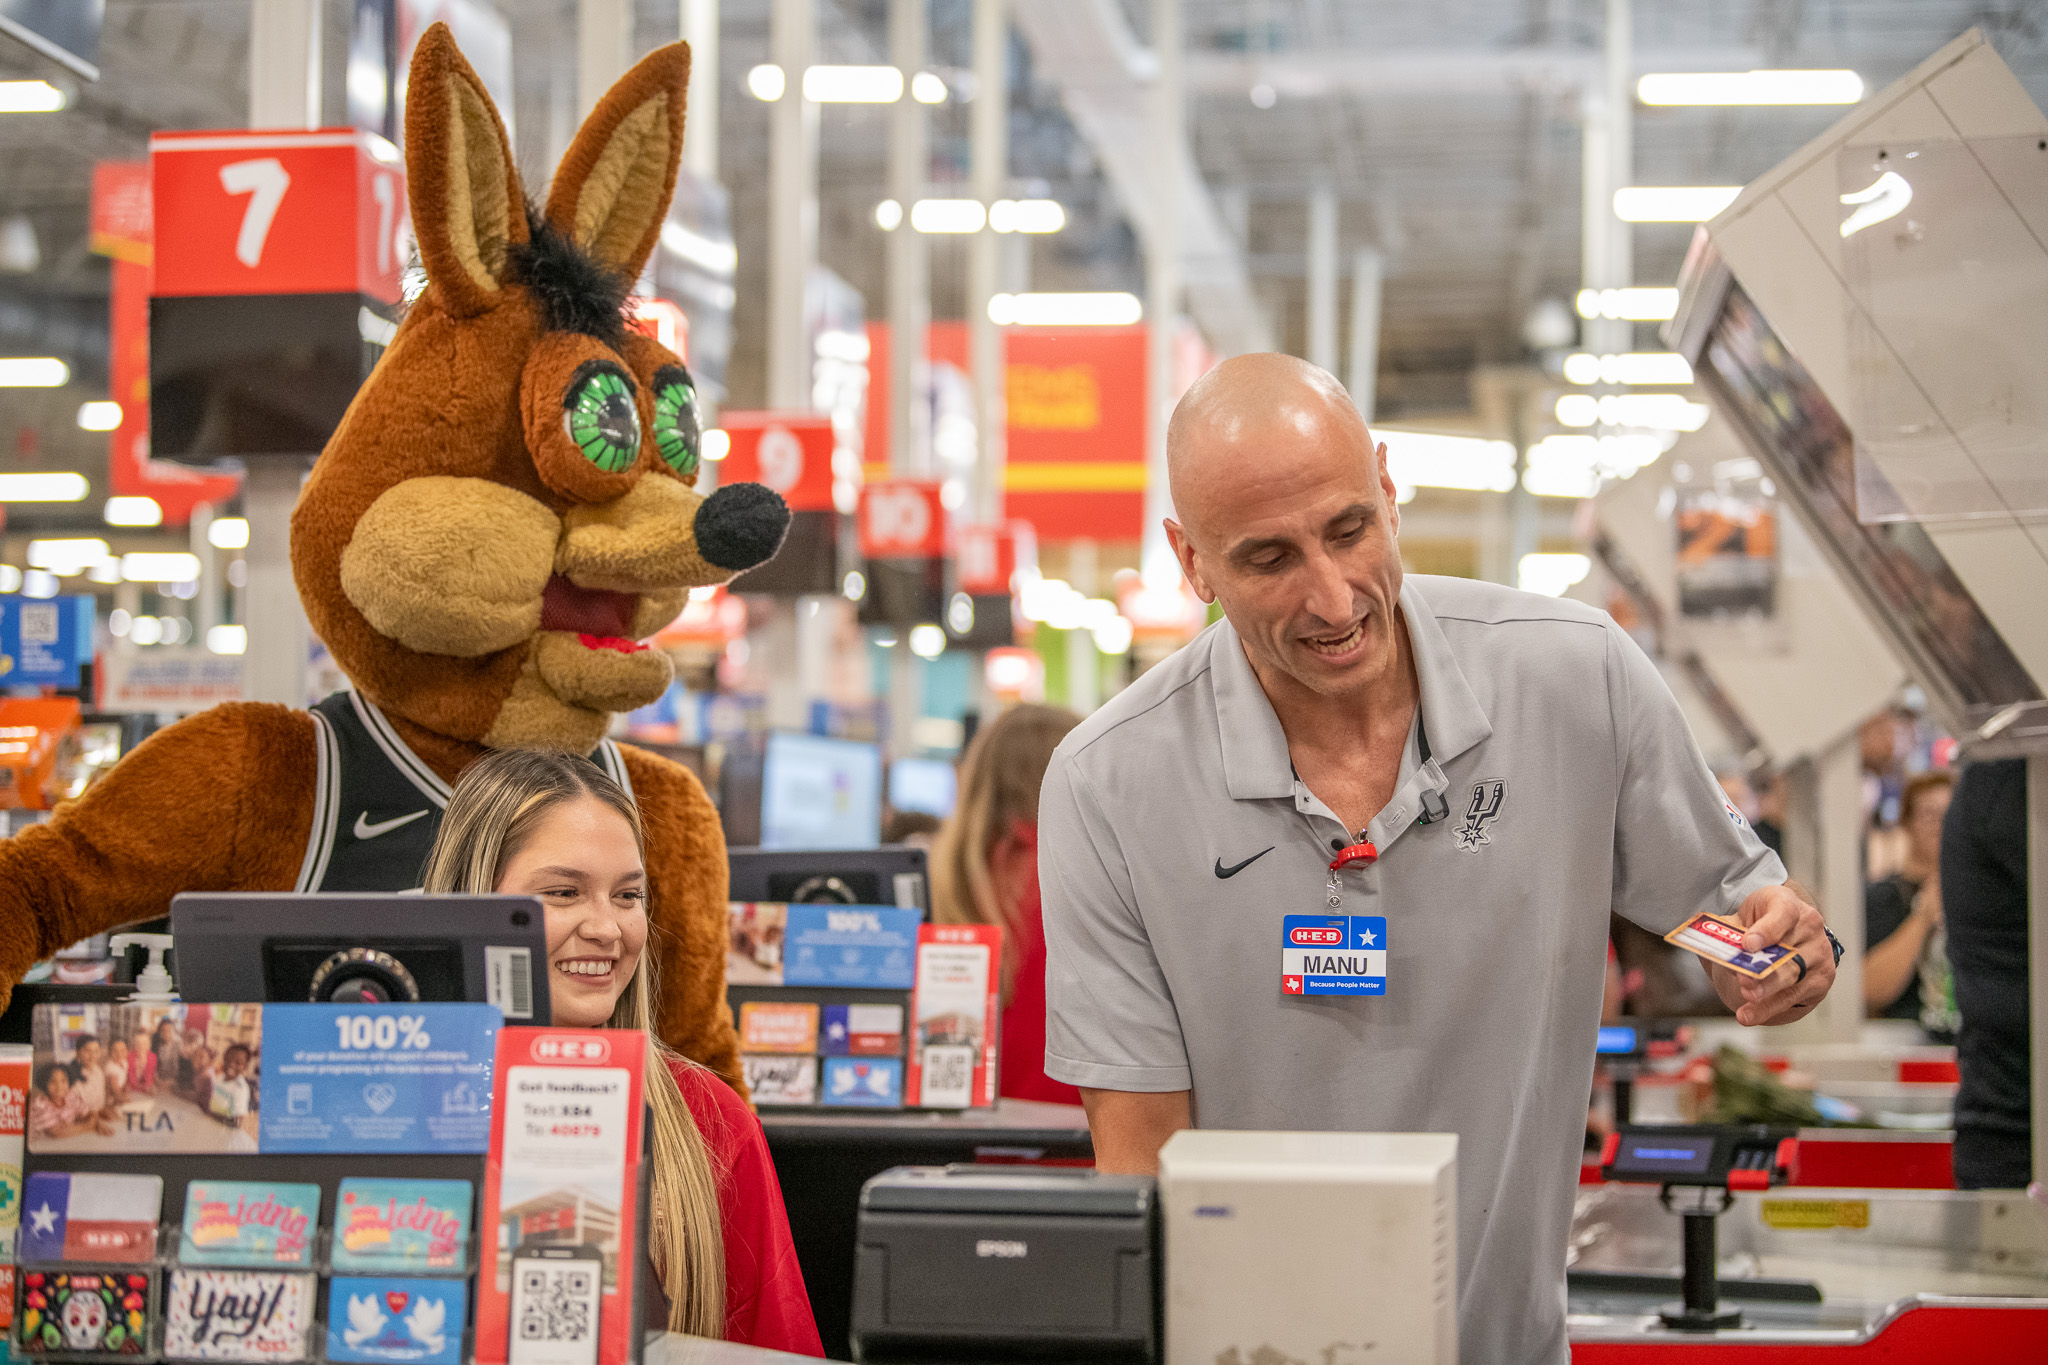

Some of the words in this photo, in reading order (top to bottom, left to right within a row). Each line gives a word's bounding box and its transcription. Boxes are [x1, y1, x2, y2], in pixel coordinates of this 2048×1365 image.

[219, 157, 292, 269] 7
[757, 425, 804, 495] 9
[867, 486, 930, 548] 10
[1303, 955, 1368, 975] MANU
[1336, 981, 1358, 989] People
[335, 1014, 431, 1050] 100%
[519, 1081, 543, 1092] Got
[547, 1081, 619, 1095] feedback?
[123, 1110, 175, 1132] TLA
[975, 1239, 1028, 1258] EPSON
